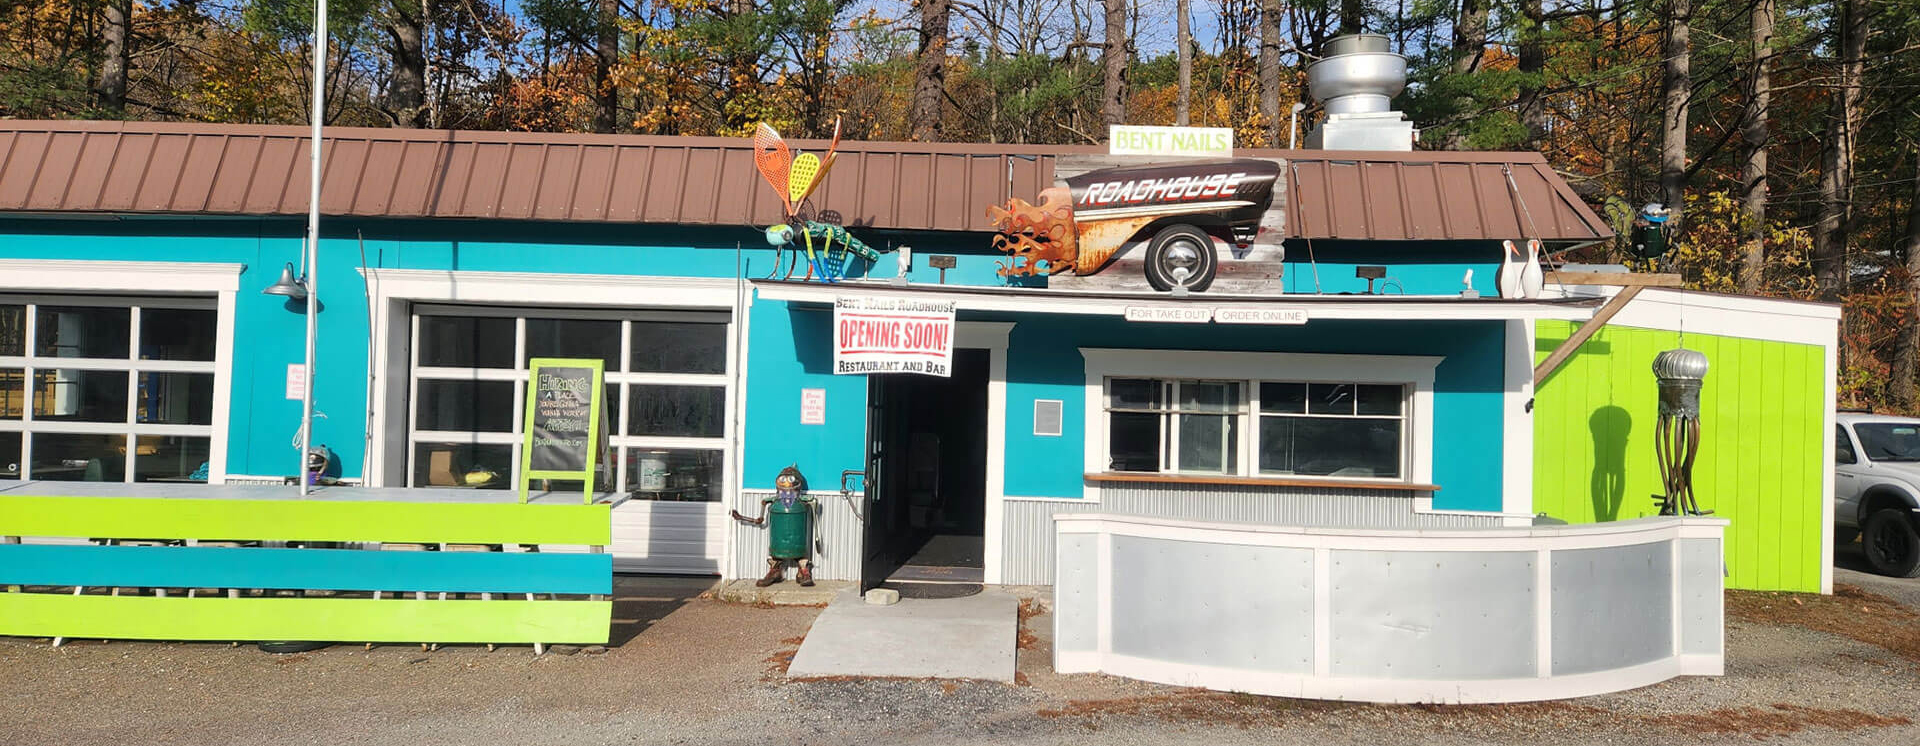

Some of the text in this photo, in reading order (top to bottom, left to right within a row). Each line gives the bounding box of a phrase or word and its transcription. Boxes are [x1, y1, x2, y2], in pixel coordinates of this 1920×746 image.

[1115, 131, 1227, 150] BENT NAILS
[1079, 173, 1247, 205] ROADHOUSE
[1130, 309, 1207, 320] FOR TAKE OUT
[1222, 311, 1302, 321] ORDER ONLINE
[840, 319, 949, 352] OPENING SOON!
[839, 360, 946, 374] RESTAURANT AND BAR
[539, 374, 589, 393] HIRING
